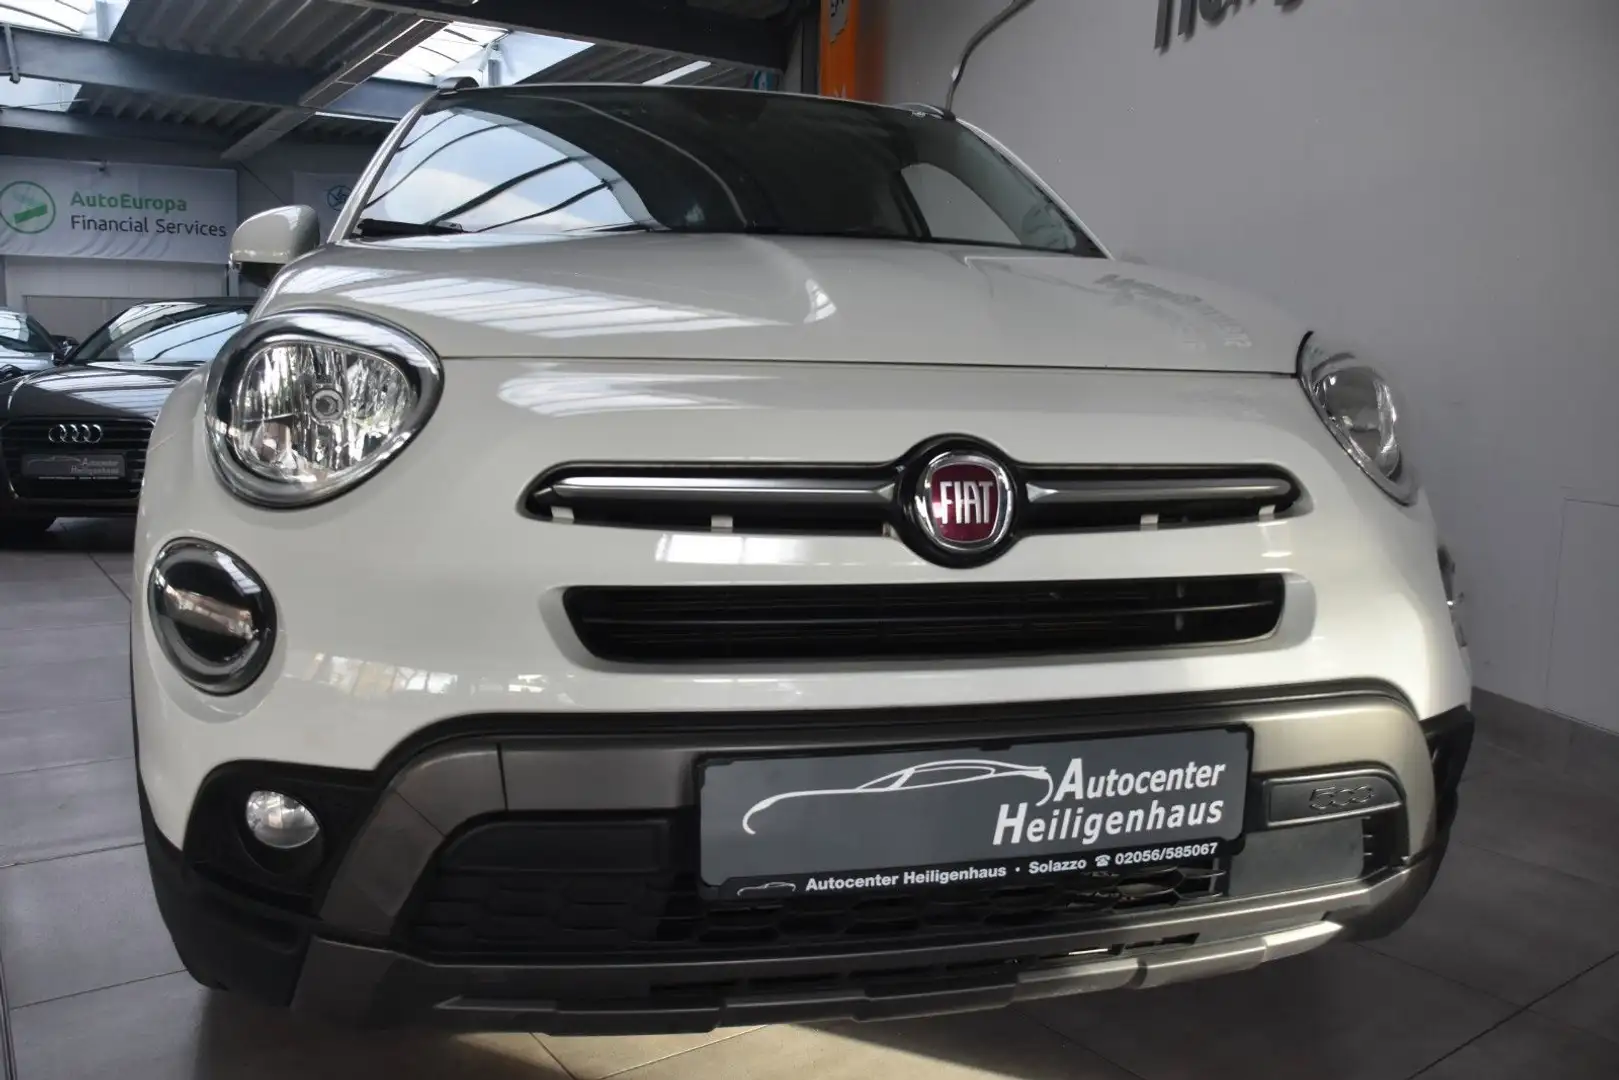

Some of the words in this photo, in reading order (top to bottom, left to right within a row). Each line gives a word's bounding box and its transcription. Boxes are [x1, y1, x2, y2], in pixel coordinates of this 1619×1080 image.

[70, 191, 188, 214] AutoEuropa
[71, 215, 149, 233] Financial
[155, 218, 228, 237] Services
[939, 480, 994, 525] FIAT
[1053, 757, 1227, 802] Autocenter
[992, 799, 1225, 846] Heiligenhaus
[805, 873, 900, 892] Autocenter
[902, 864, 1008, 885] Heiligenhaus
[1028, 858, 1088, 875] Solazzo
[1114, 842, 1219, 866] 02056/585067
